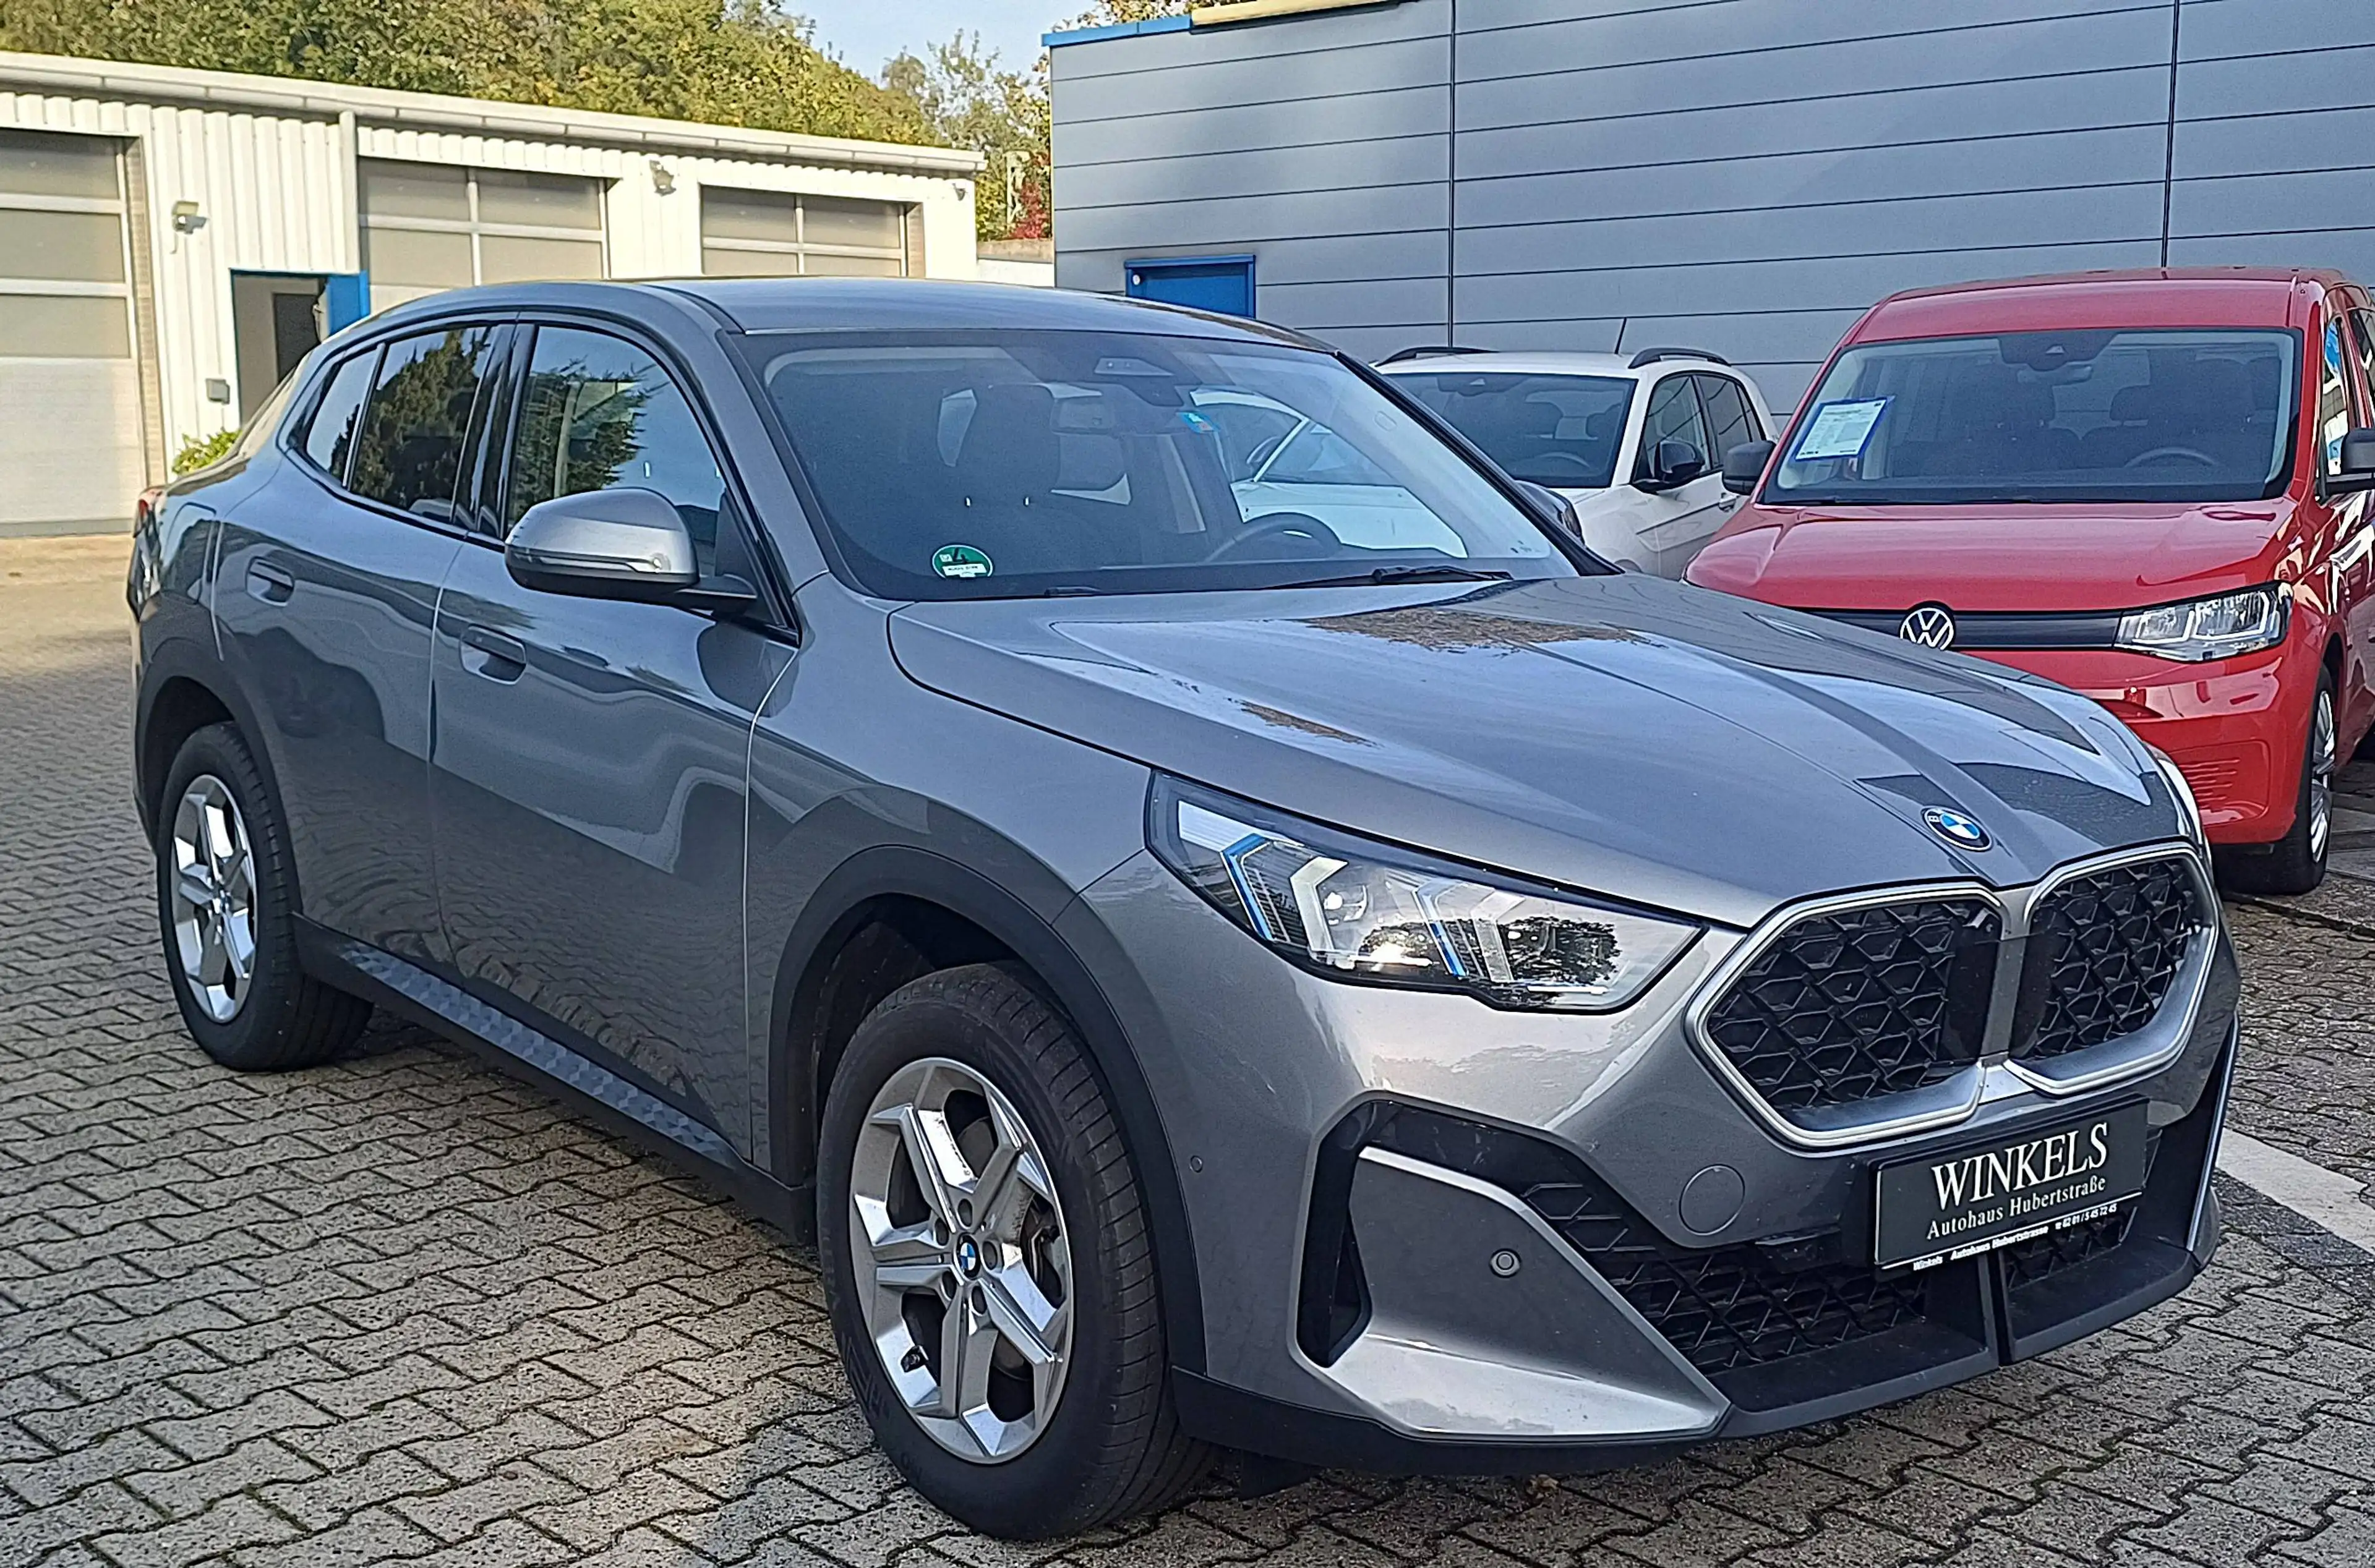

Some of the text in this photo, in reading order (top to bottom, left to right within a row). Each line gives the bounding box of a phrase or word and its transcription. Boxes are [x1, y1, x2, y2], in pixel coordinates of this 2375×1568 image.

[1904, 608, 1952, 649] VW
[1931, 1122, 2107, 1211] WINKELS
[1927, 1175, 2106, 1240] Autohaus Hubertstraße
